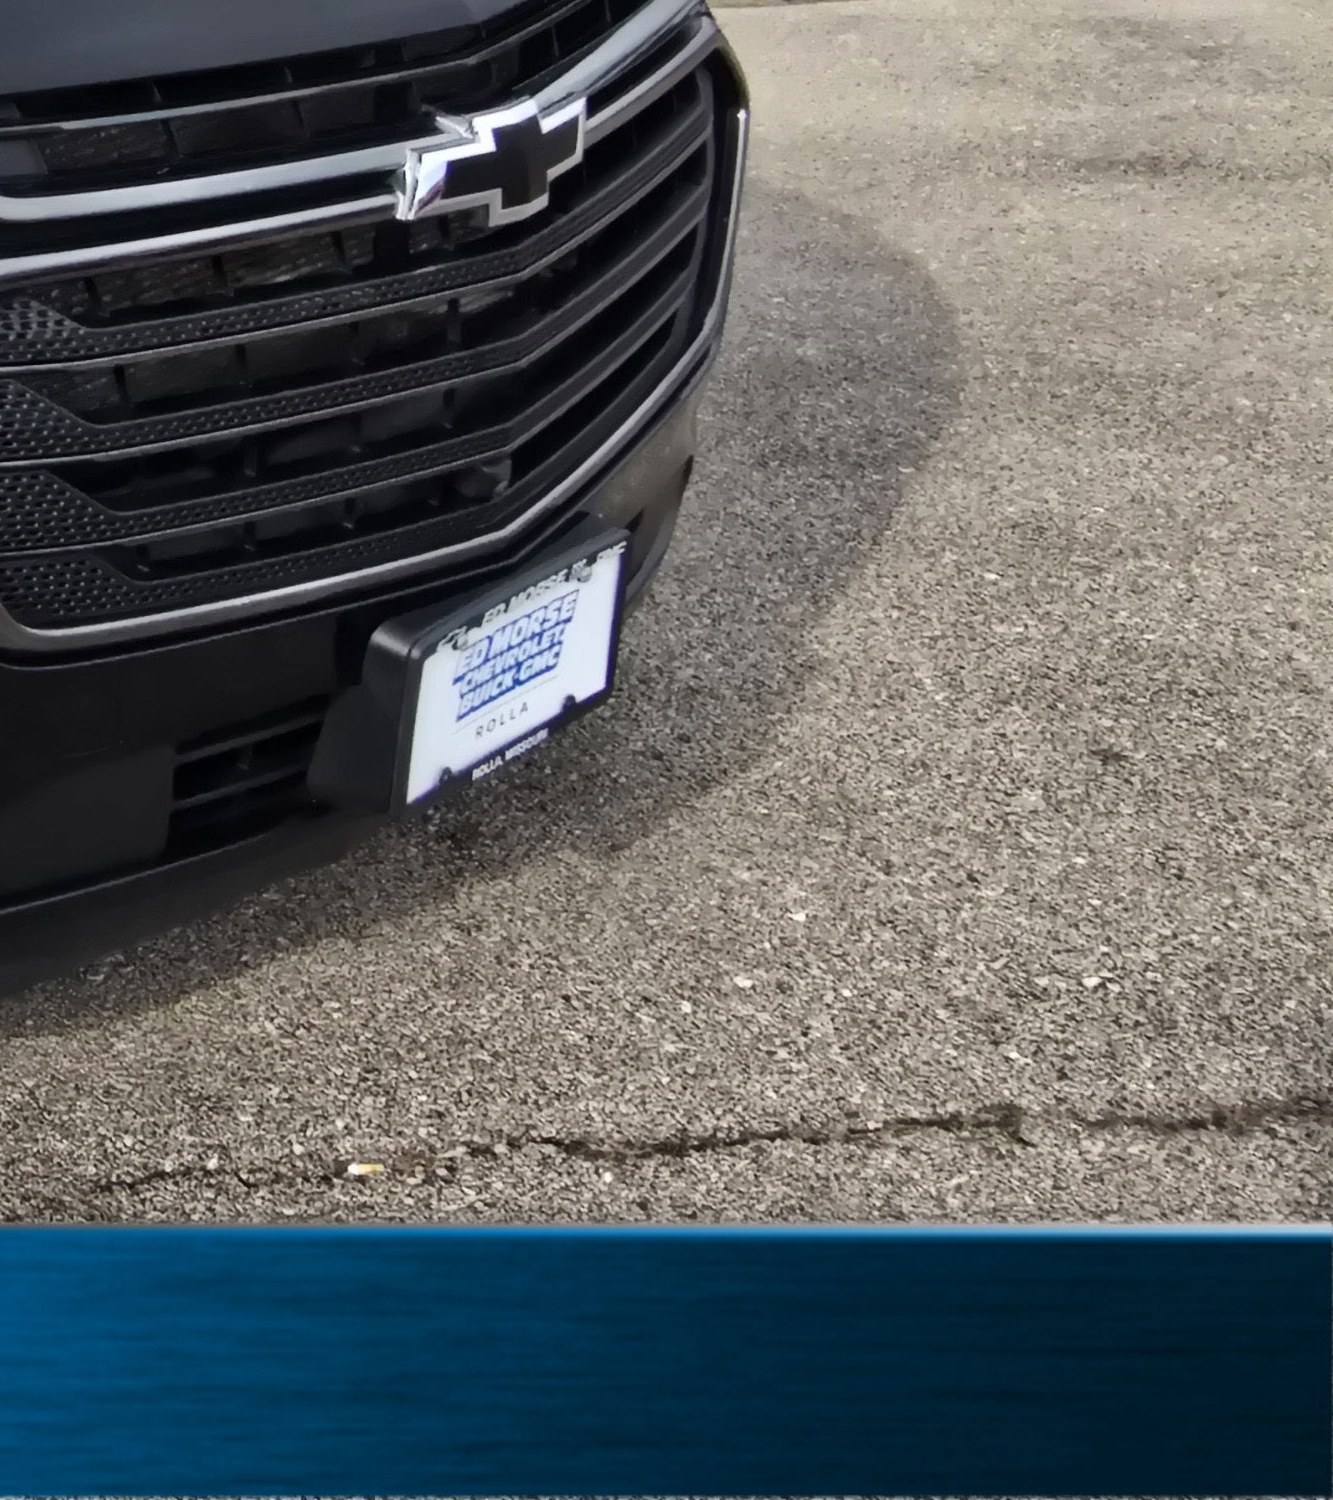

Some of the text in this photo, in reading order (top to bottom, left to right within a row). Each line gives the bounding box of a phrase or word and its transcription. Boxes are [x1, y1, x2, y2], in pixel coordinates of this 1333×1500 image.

[457, 589, 577, 677] ED MORSE
[462, 623, 566, 693] CHEVROLET
[475, 702, 528, 738] ROLLA
